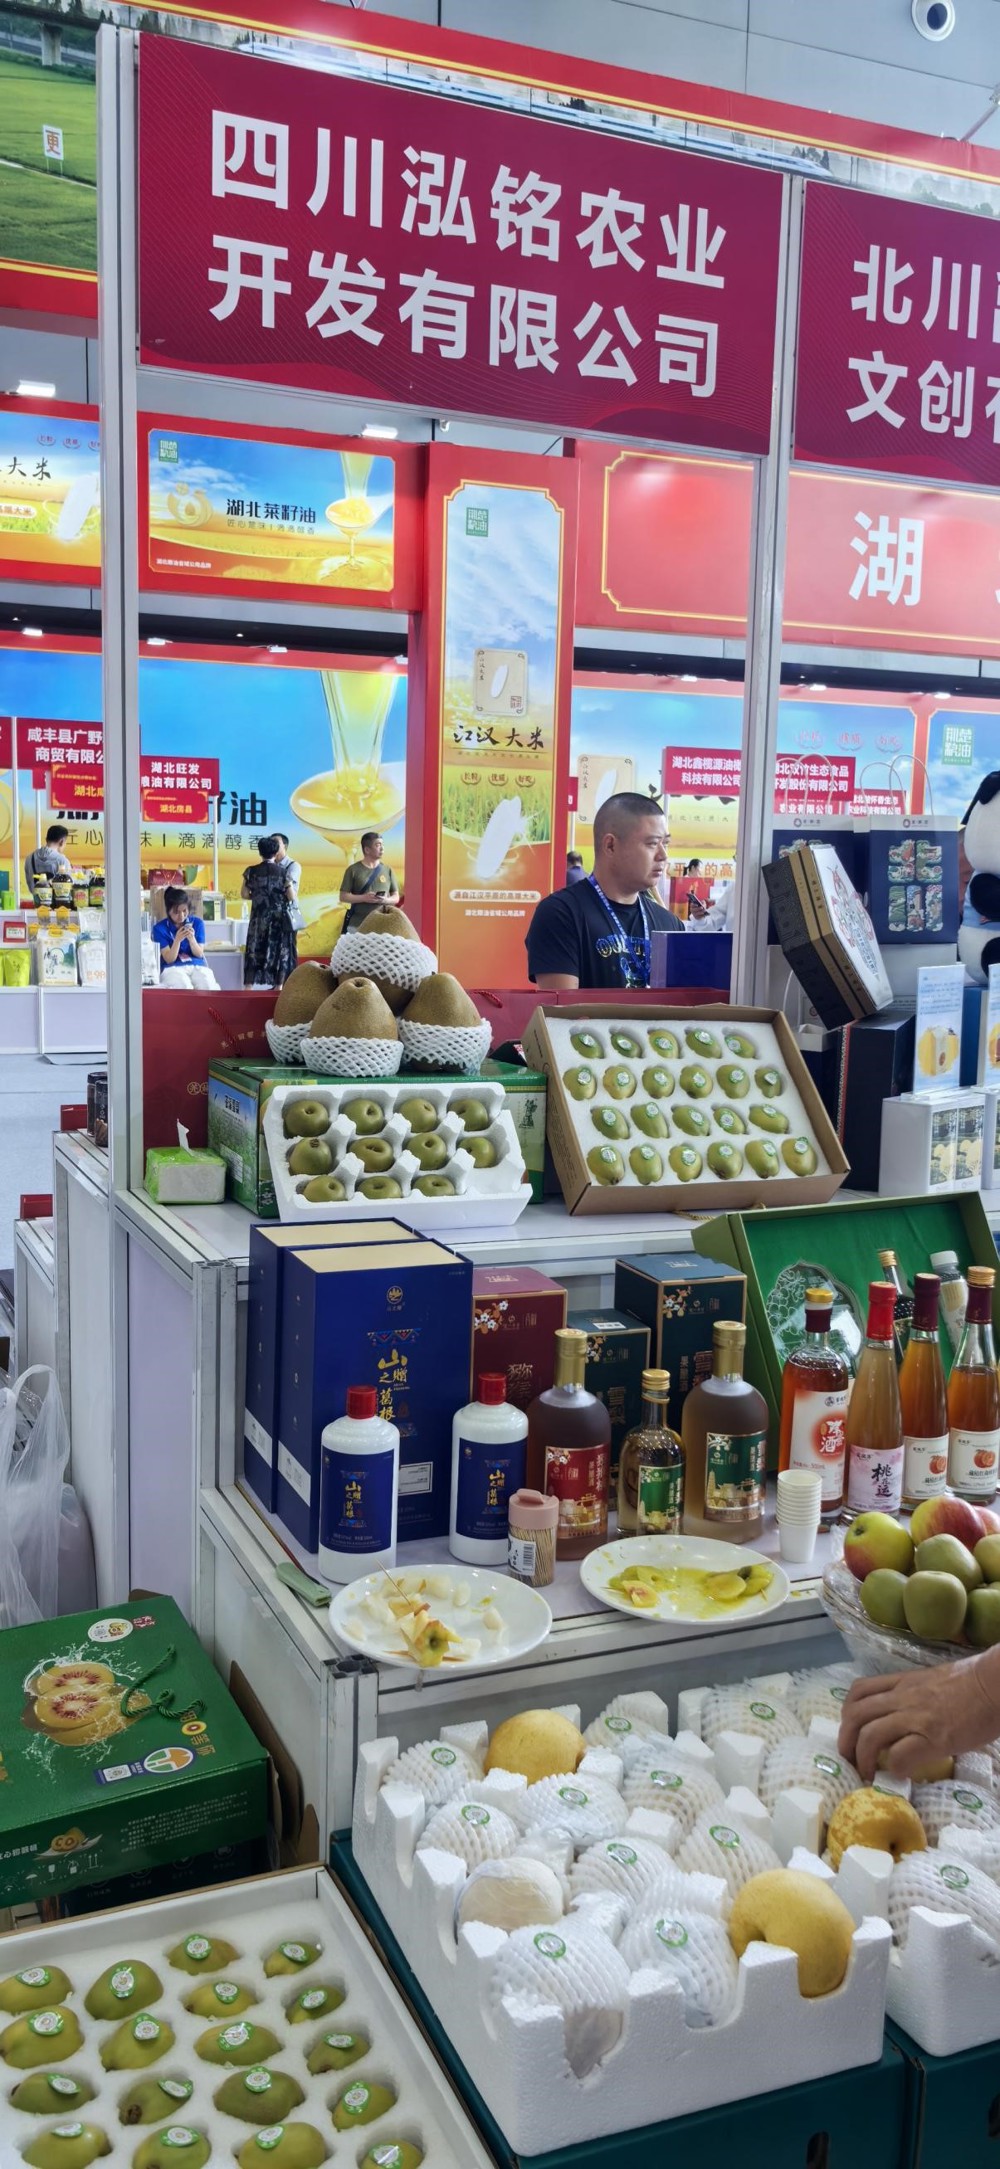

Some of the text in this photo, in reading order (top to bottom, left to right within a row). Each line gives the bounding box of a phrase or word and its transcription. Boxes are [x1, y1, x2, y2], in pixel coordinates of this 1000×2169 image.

[45, 130, 62, 156] 更
[211, 109, 727, 289] 四川泓铭农业
[851, 244, 1000, 344] 北川
[207, 234, 720, 399] 开发有限公司
[226, 498, 316, 524] 湖北菜籽油
[849, 510, 925, 606] 湖
[27, 727, 104, 745] 咸丰县广野
[453, 725, 544, 750] 江汉大米
[151, 761, 200, 775] 湖北旺发
